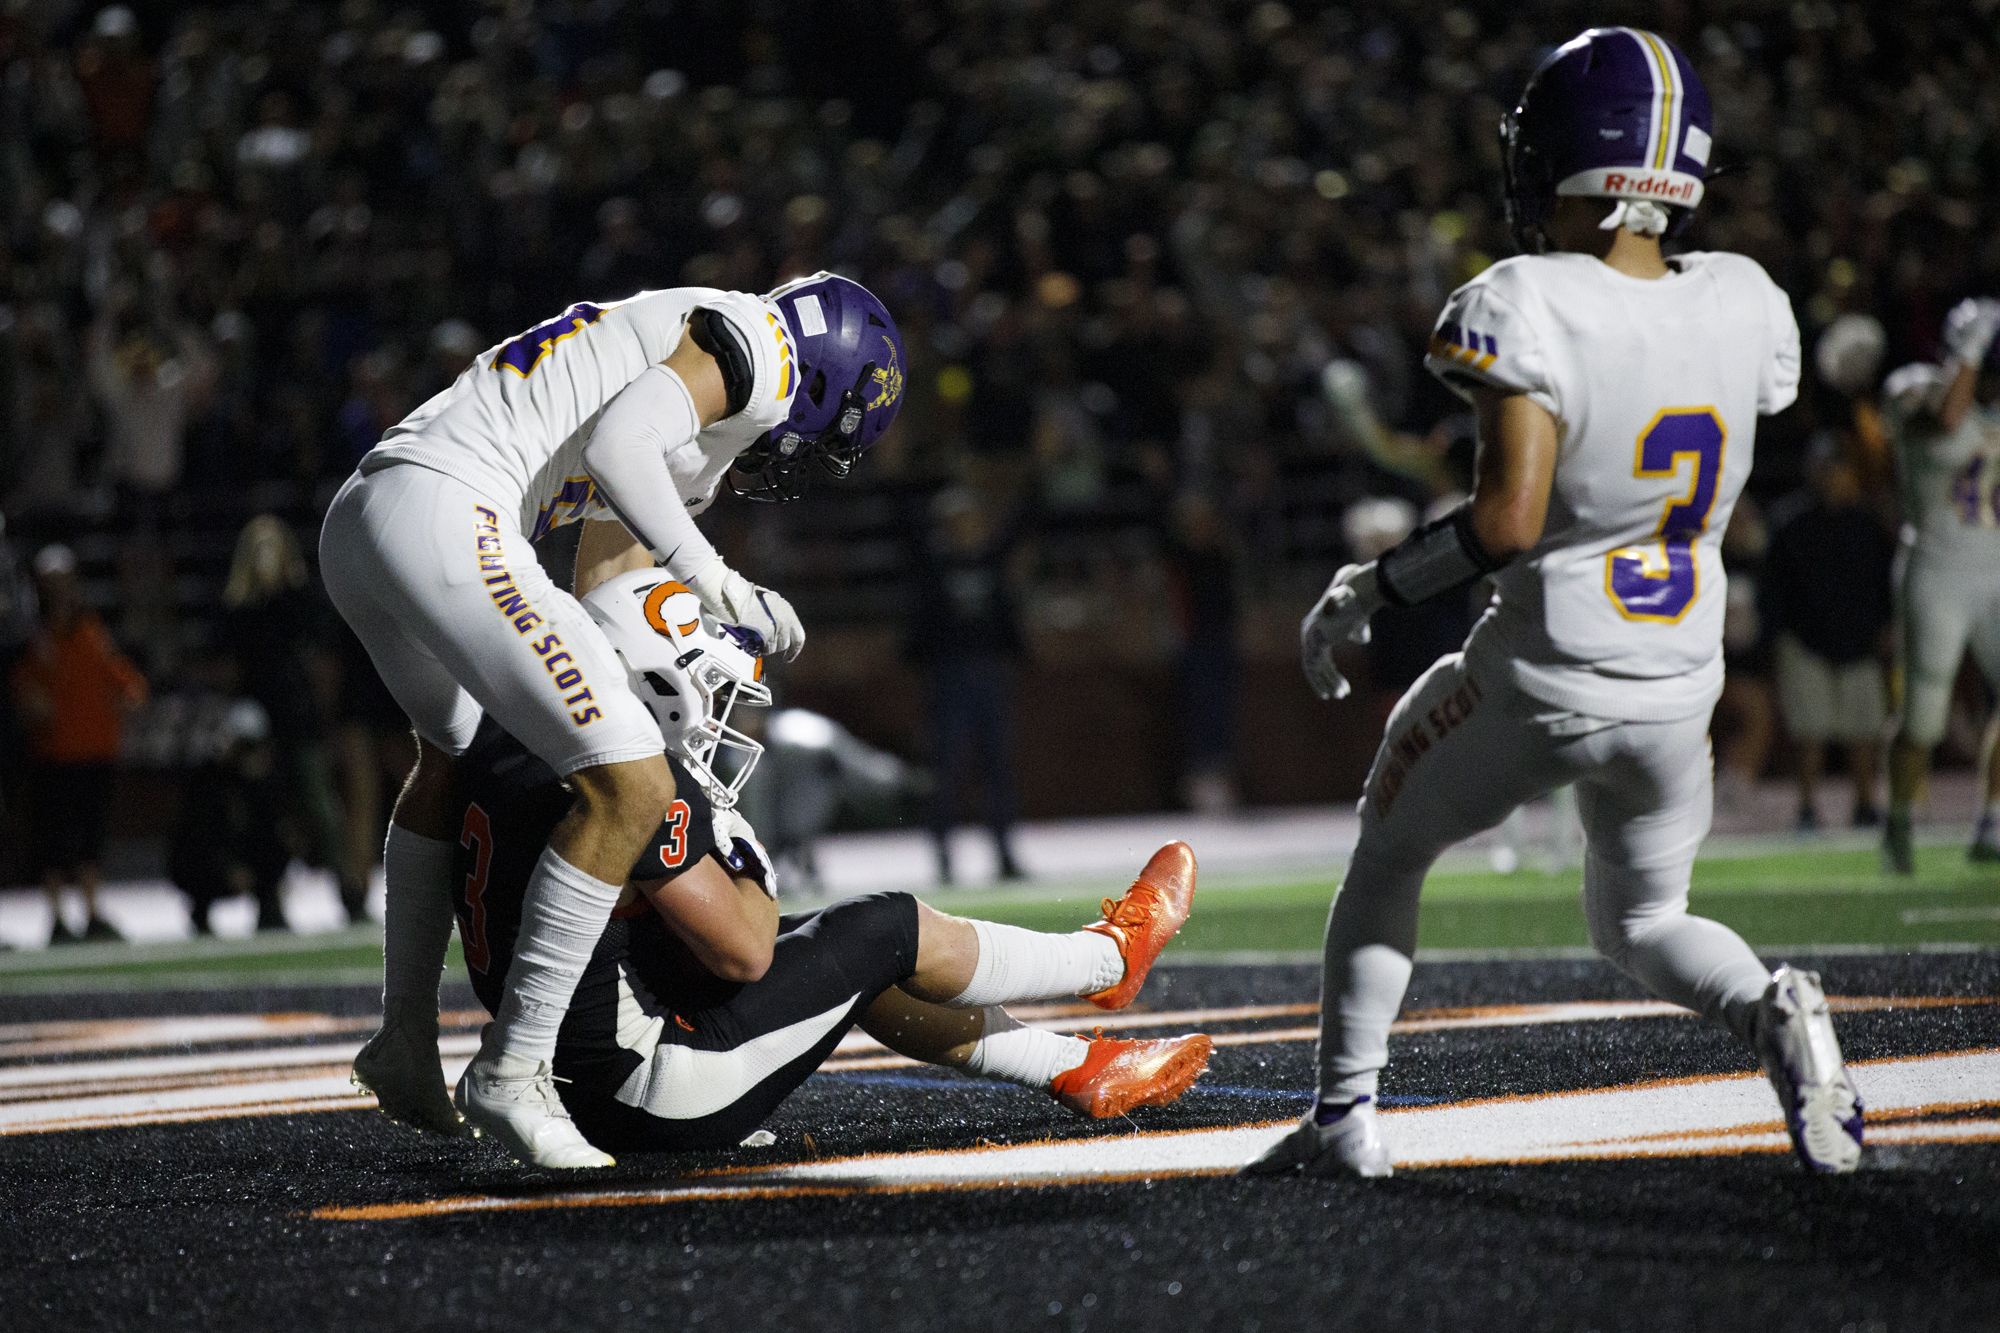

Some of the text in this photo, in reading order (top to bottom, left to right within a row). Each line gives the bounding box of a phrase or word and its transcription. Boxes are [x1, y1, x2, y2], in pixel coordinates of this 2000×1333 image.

[1605, 173, 1694, 199] Riddell
[1604, 404, 1729, 626] 3
[473, 503, 545, 637] FIGHTING
[529, 632, 604, 728] SCOTS
[457, 801, 494, 976] 3
[660, 798, 691, 868] 3
